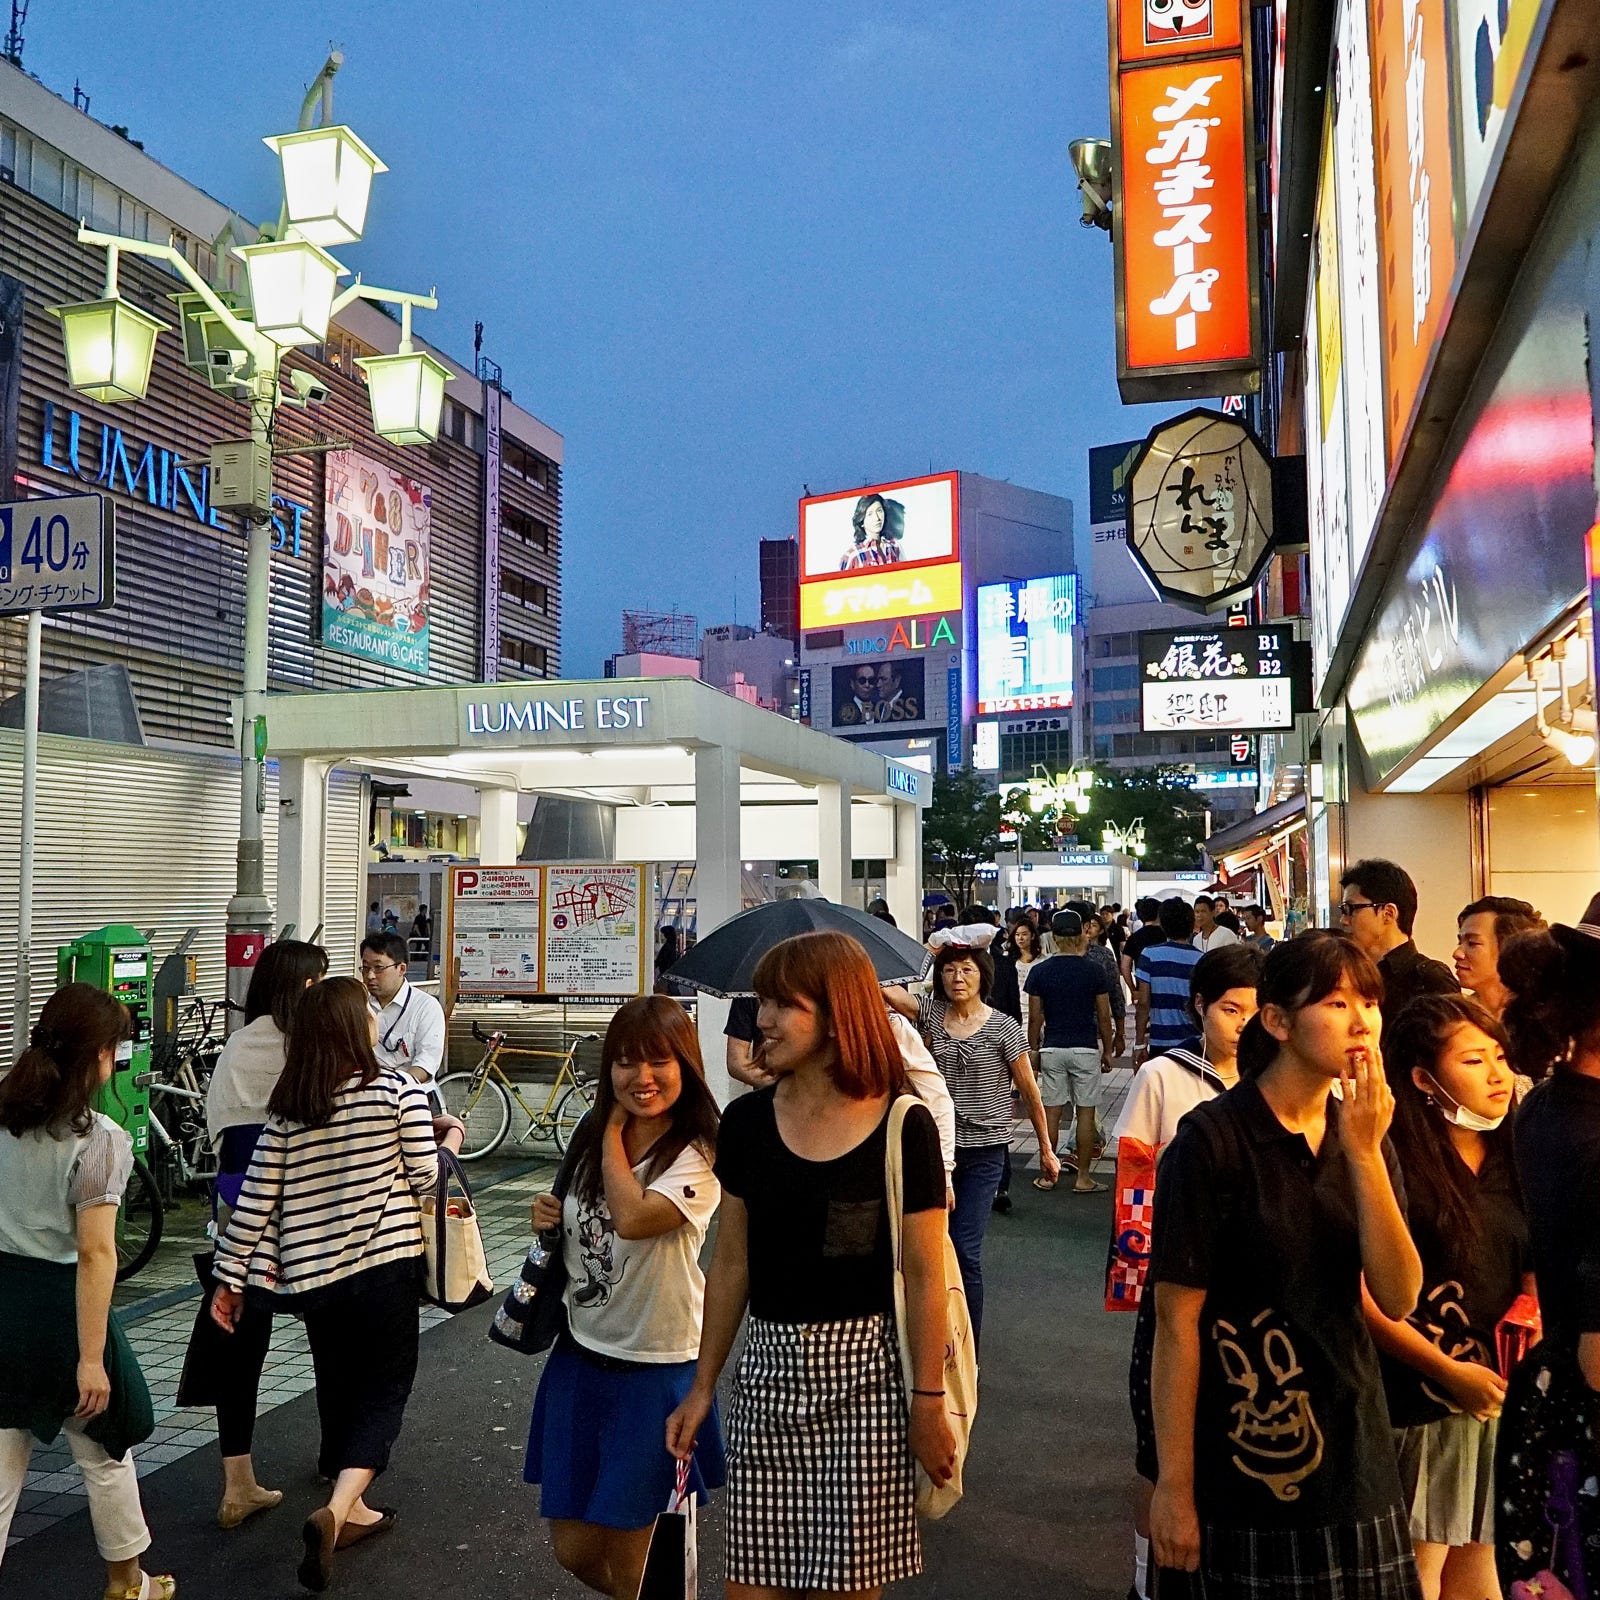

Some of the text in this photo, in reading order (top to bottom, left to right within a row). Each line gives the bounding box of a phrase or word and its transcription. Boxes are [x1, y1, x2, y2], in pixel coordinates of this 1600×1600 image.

[1145, 75, 1223, 351] メガネスーパー
[0, 582, 95, 606] ング・チケット
[822, 580, 934, 616] タマホーム
[887, 616, 957, 652] ALTA
[1258, 635, 1280, 650] B1
[1258, 660, 1281, 675] B2
[467, 697, 649, 734] LUMINE EST
[1060, 854, 1109, 864] LUMINE EST
[458, 871, 478, 896] P
